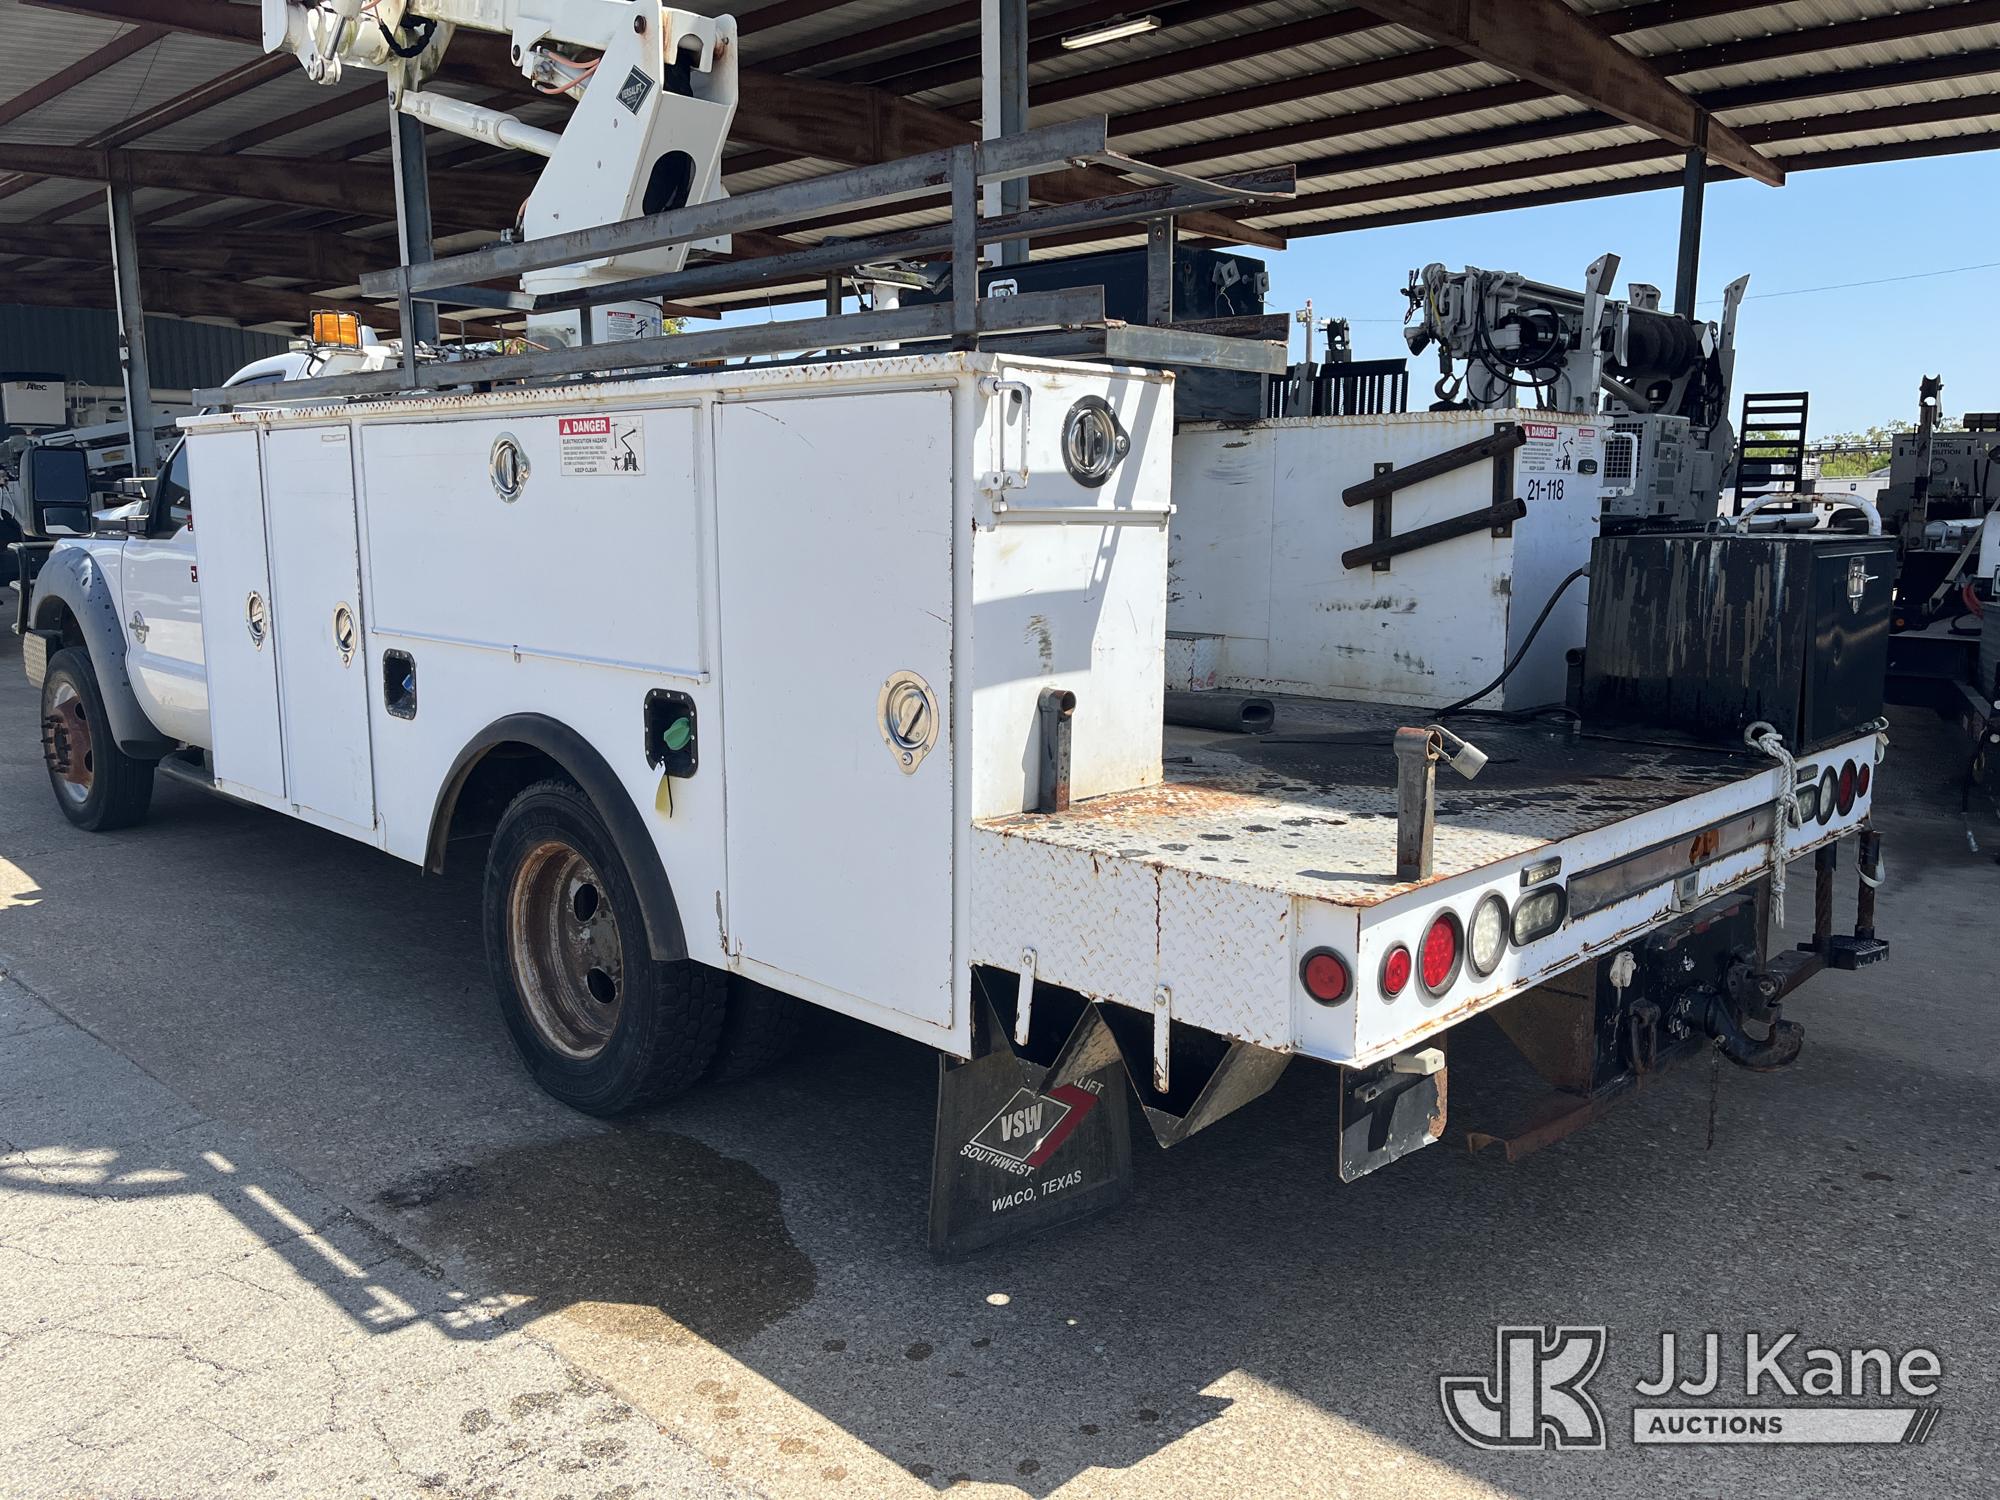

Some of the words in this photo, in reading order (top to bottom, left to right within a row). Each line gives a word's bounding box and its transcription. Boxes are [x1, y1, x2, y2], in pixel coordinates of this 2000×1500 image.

[572, 419, 607, 433] DANGER
[1531, 426, 1556, 438] DANGER
[1527, 479, 1564, 501] 21-118
[1001, 1103, 1043, 1142] VSW
[959, 1144, 1035, 1178] SOUTHWEST
[992, 1187, 1037, 1213] WACO,
[1041, 1169, 1082, 1196] TEXAS
